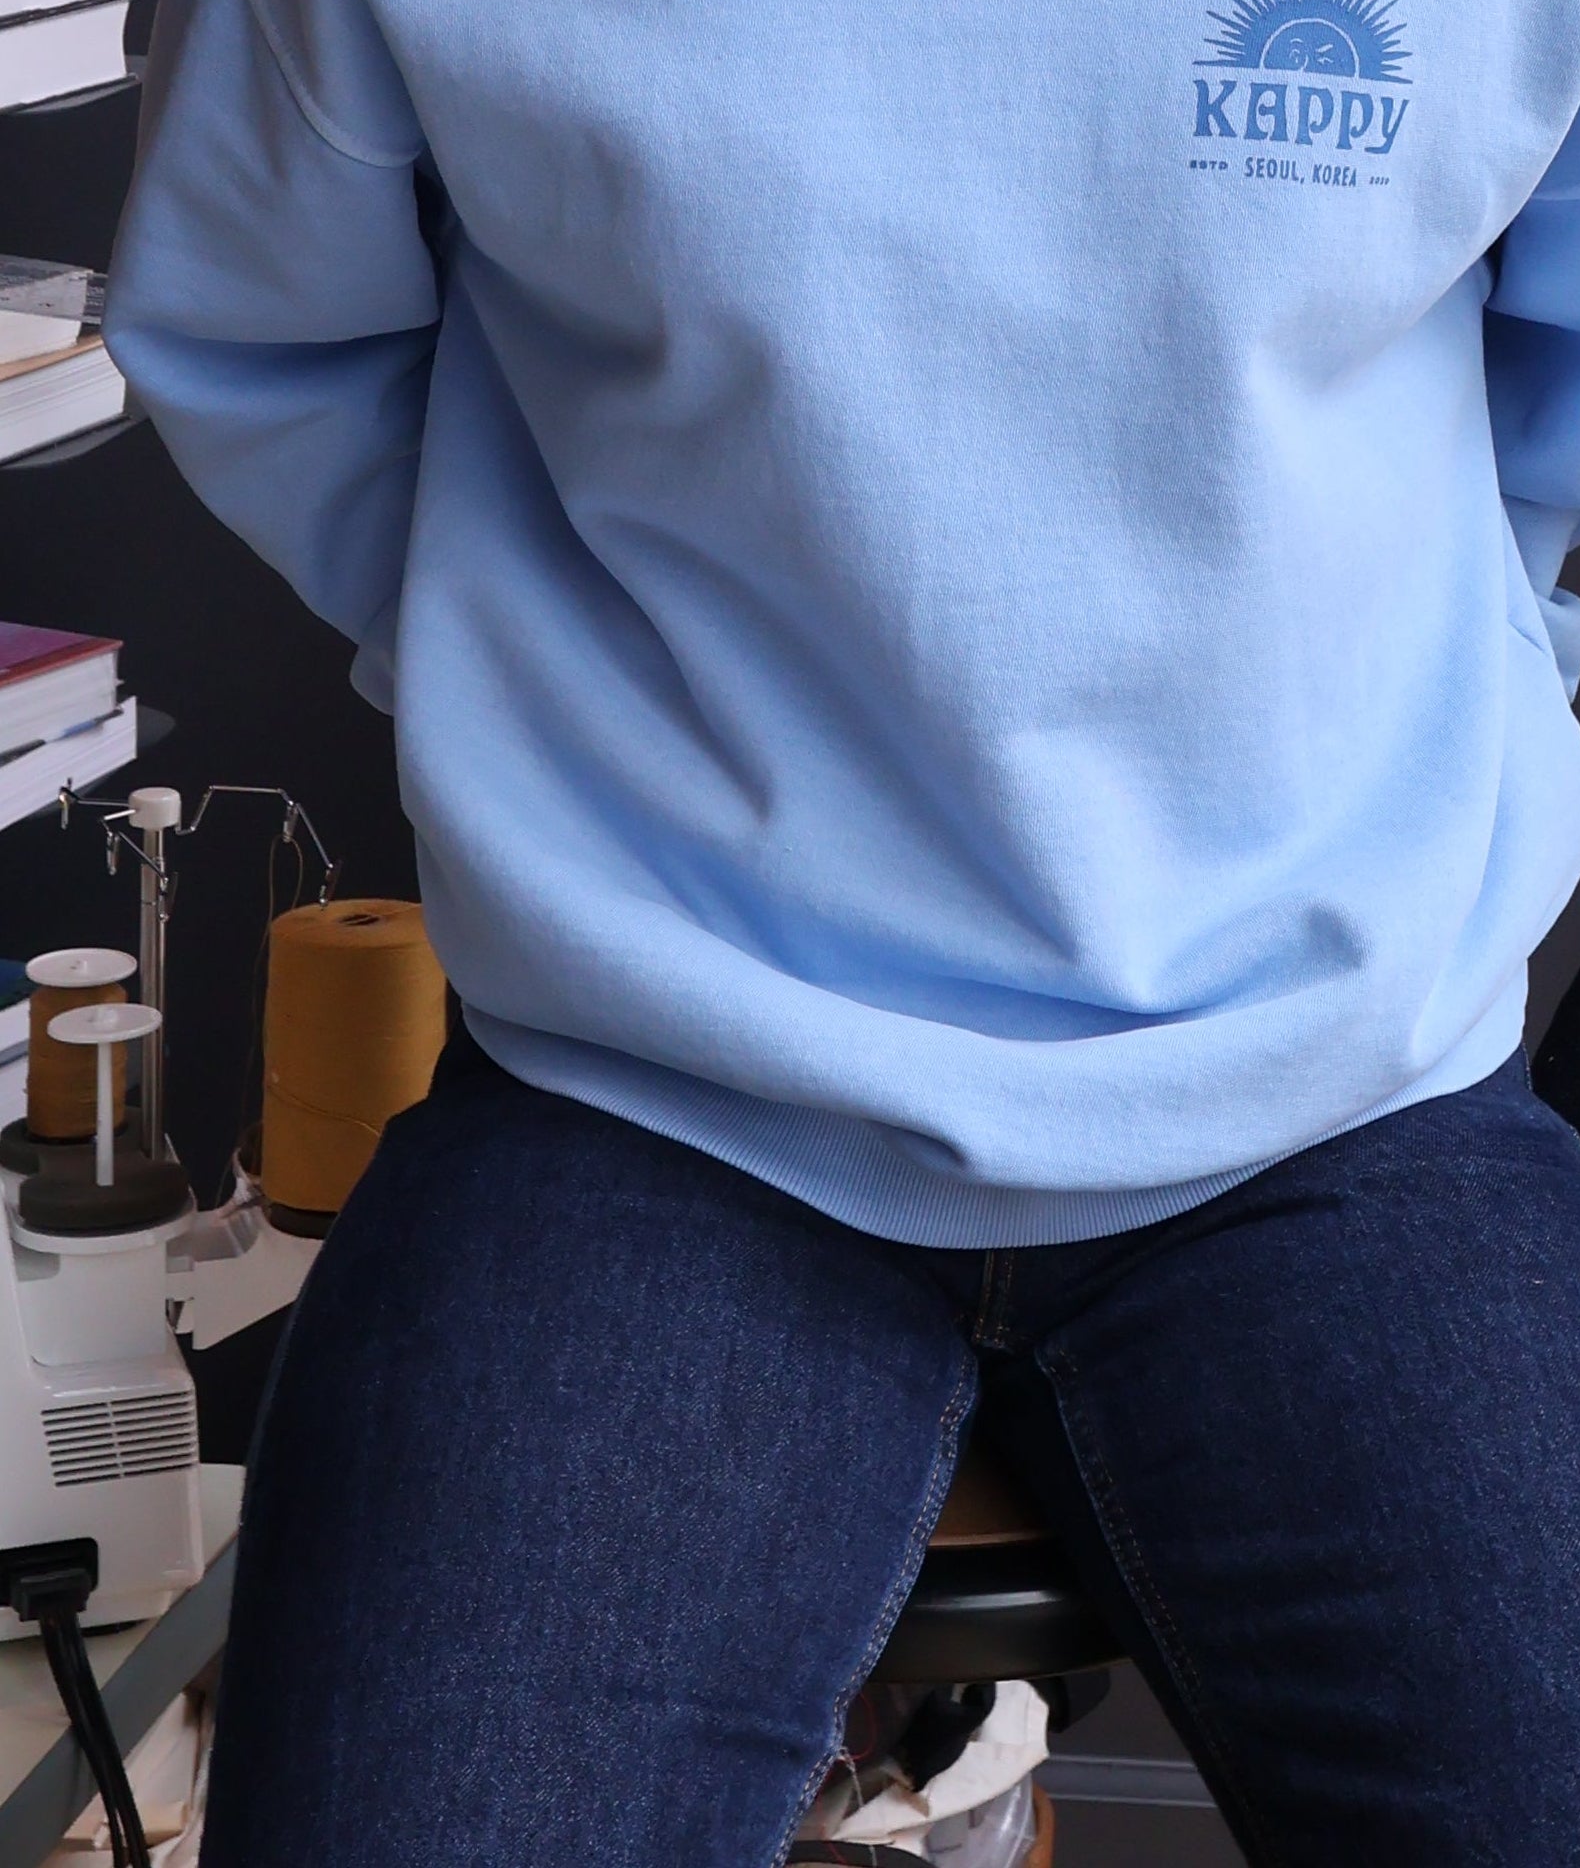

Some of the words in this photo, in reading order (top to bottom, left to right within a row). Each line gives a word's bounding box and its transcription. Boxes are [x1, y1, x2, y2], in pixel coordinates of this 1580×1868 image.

[1192, 79, 1411, 154] KAPPY
[1244, 156, 1305, 185] SEOUL,
[1312, 163, 1357, 188] KOREA
